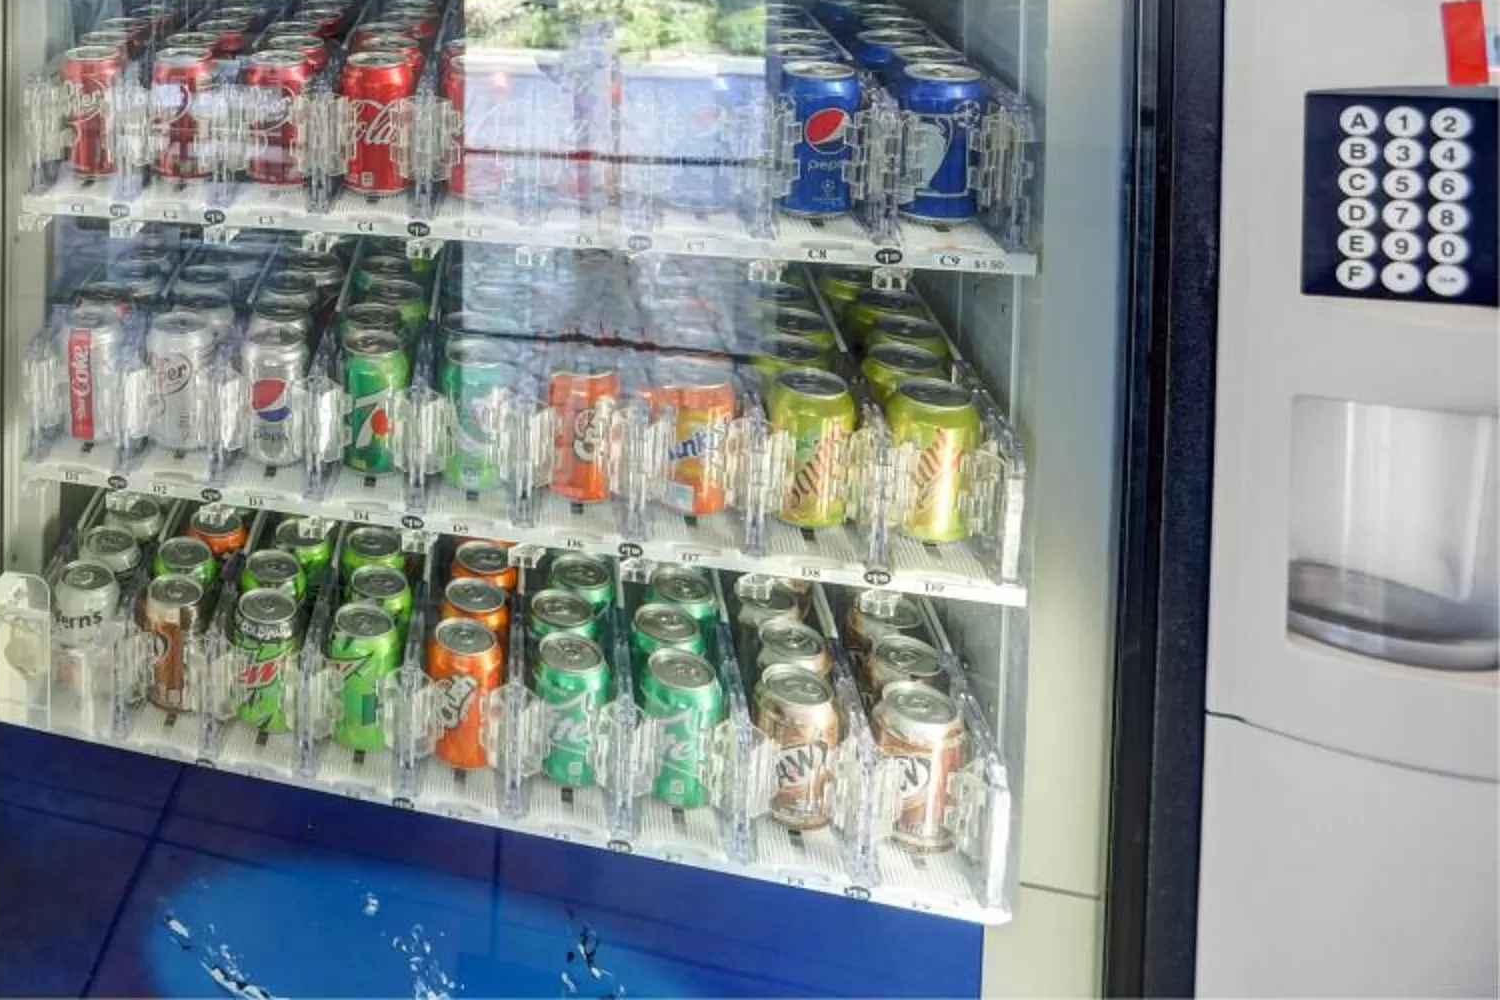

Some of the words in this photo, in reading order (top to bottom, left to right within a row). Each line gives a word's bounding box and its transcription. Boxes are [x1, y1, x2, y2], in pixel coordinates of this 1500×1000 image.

[1350, 112, 1367, 129] A
[1442, 116, 1457, 132] 2
[1350, 143, 1366, 159] B
[1396, 146, 1410, 162] 3
[1441, 148, 1456, 164] 4
[1349, 174, 1366, 190] C
[1396, 176, 1409, 192] 5
[1441, 178, 1455, 195] 6
[1349, 205, 1366, 221] D
[1395, 208, 1408, 223] 7
[1440, 210, 1455, 226] 8
[808, 249, 827, 259] C8
[1349, 236, 1364, 252] E
[1395, 238, 1409, 255] 9
[1441, 241, 1455, 257] 0
[940, 255, 960, 266] C9
[1348, 267, 1361, 282] F
